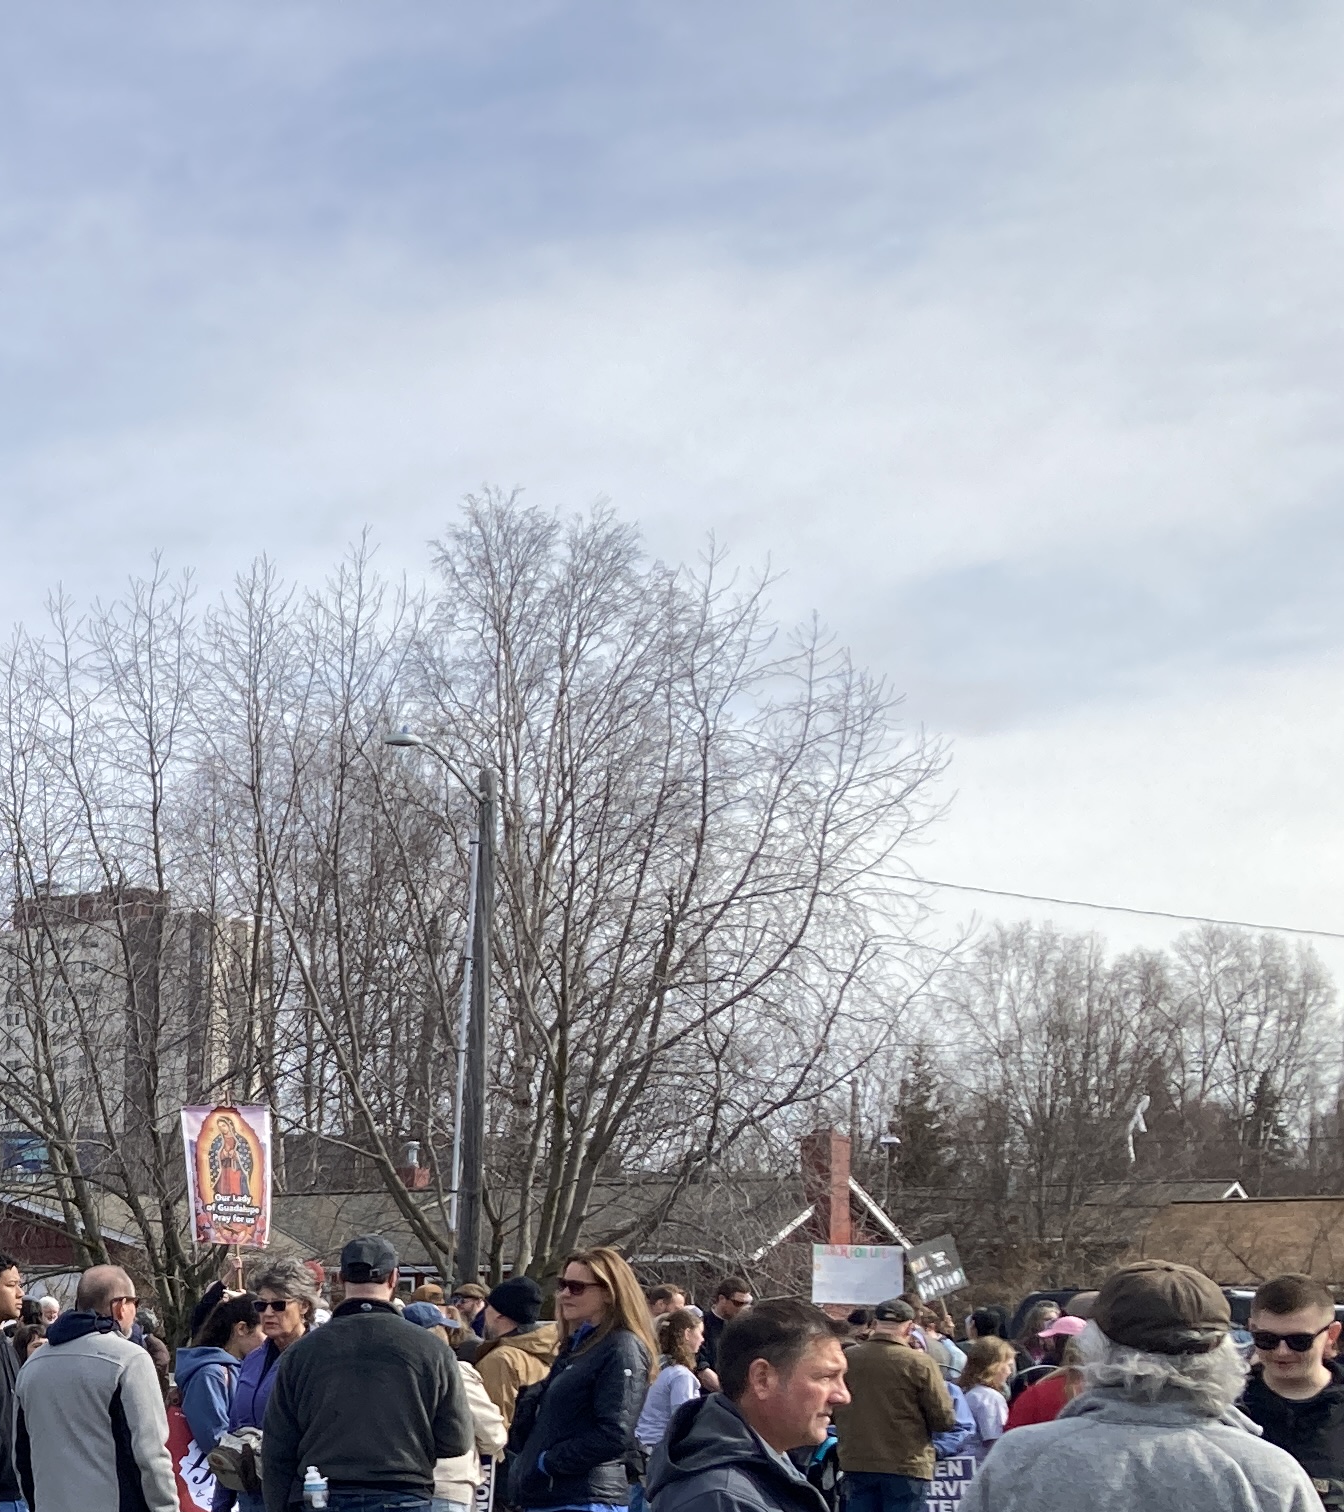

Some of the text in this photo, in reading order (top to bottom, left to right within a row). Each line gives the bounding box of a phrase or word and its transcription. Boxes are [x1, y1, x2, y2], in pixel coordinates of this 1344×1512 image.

[214, 1193, 252, 1204] Our Lady
[206, 1203, 260, 1214] of Guadalupe
[213, 1214, 231, 1223] Pray
[232, 1214, 244, 1223] for
